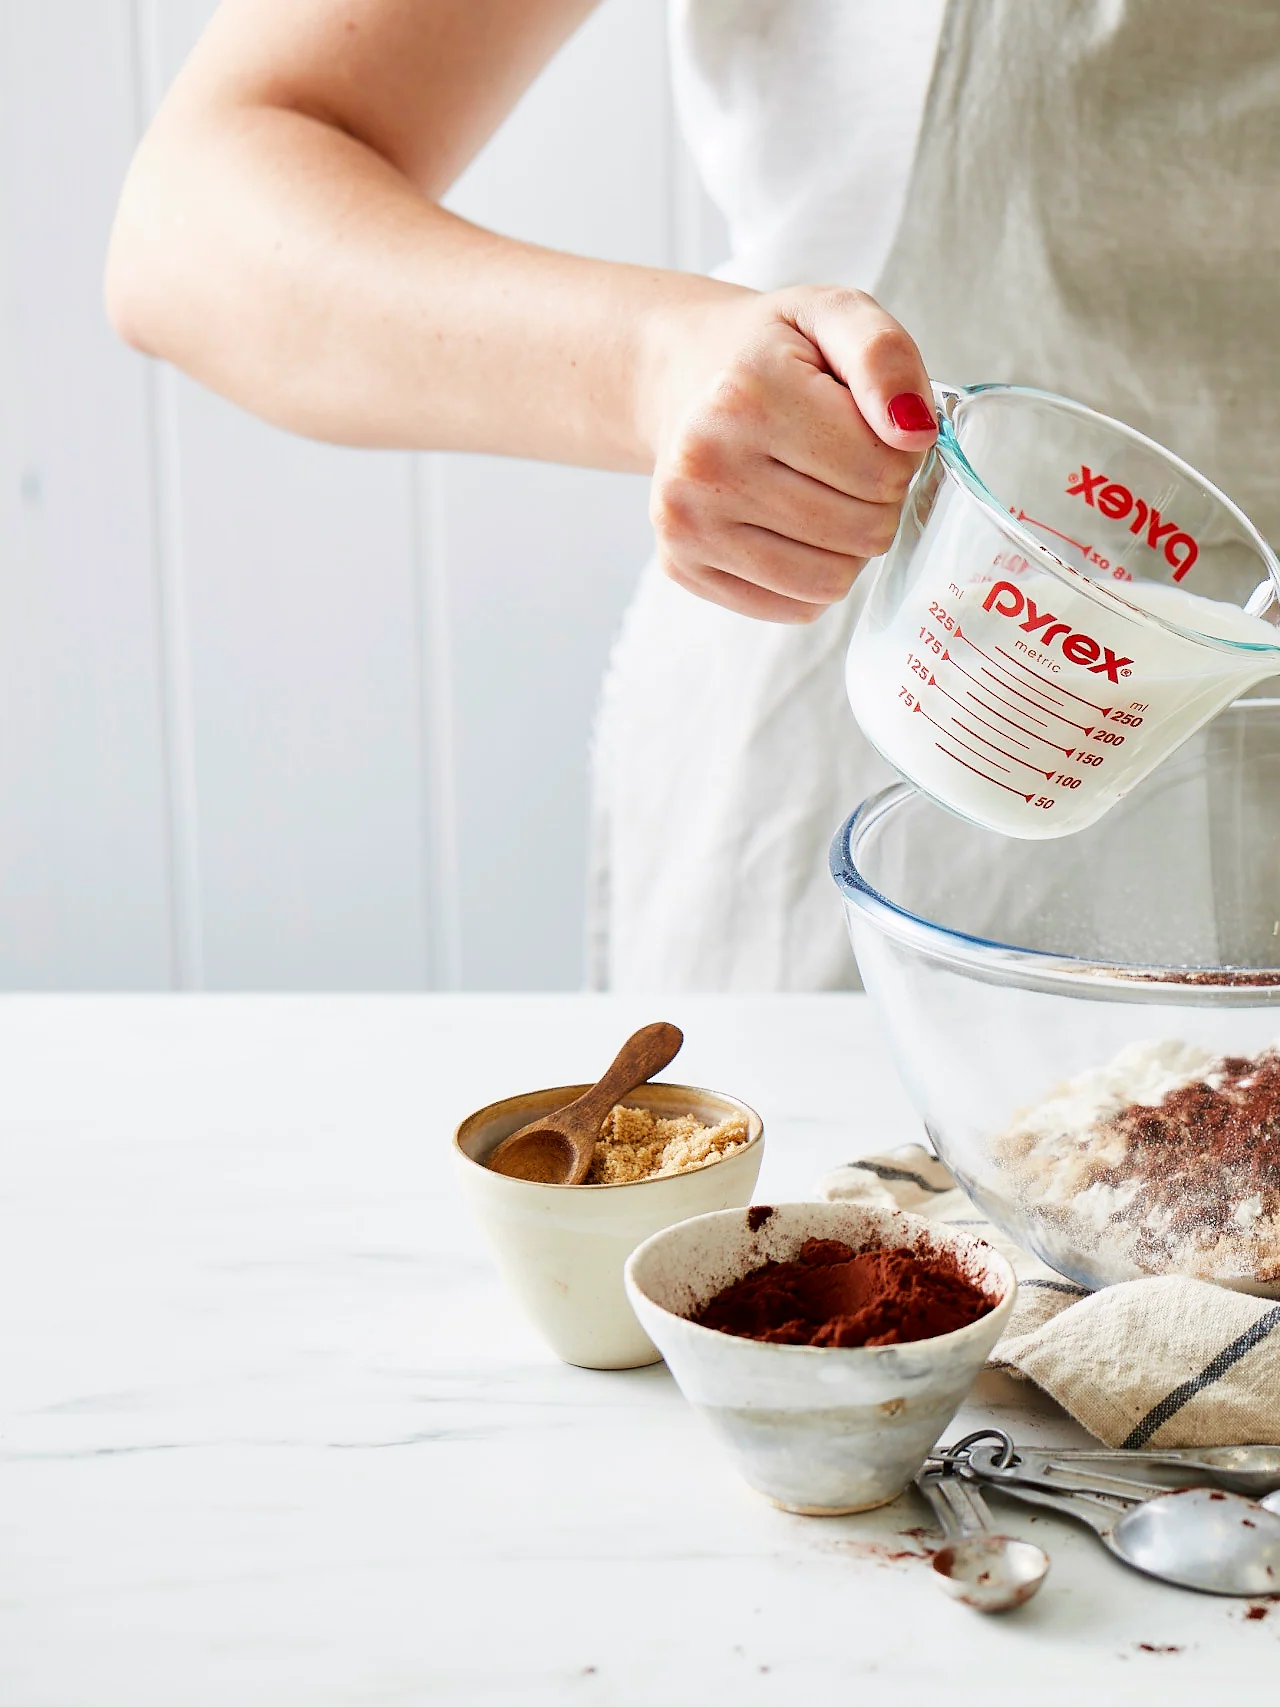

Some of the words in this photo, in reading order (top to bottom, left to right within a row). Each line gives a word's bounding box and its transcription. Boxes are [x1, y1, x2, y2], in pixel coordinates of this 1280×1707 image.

[948, 582, 965, 600] ml
[928, 601, 956, 632] 225
[919, 626, 943, 655] 175
[1014, 639, 1062, 673] metric
[907, 653, 930, 681] 125
[898, 685, 915, 707] 75
[1129, 701, 1150, 713] ml
[1109, 710, 1144, 728] 250
[1093, 730, 1125, 747] 200
[1075, 751, 1104, 767] 150
[1055, 774, 1082, 789] 100
[1034, 796, 1055, 809] 50
